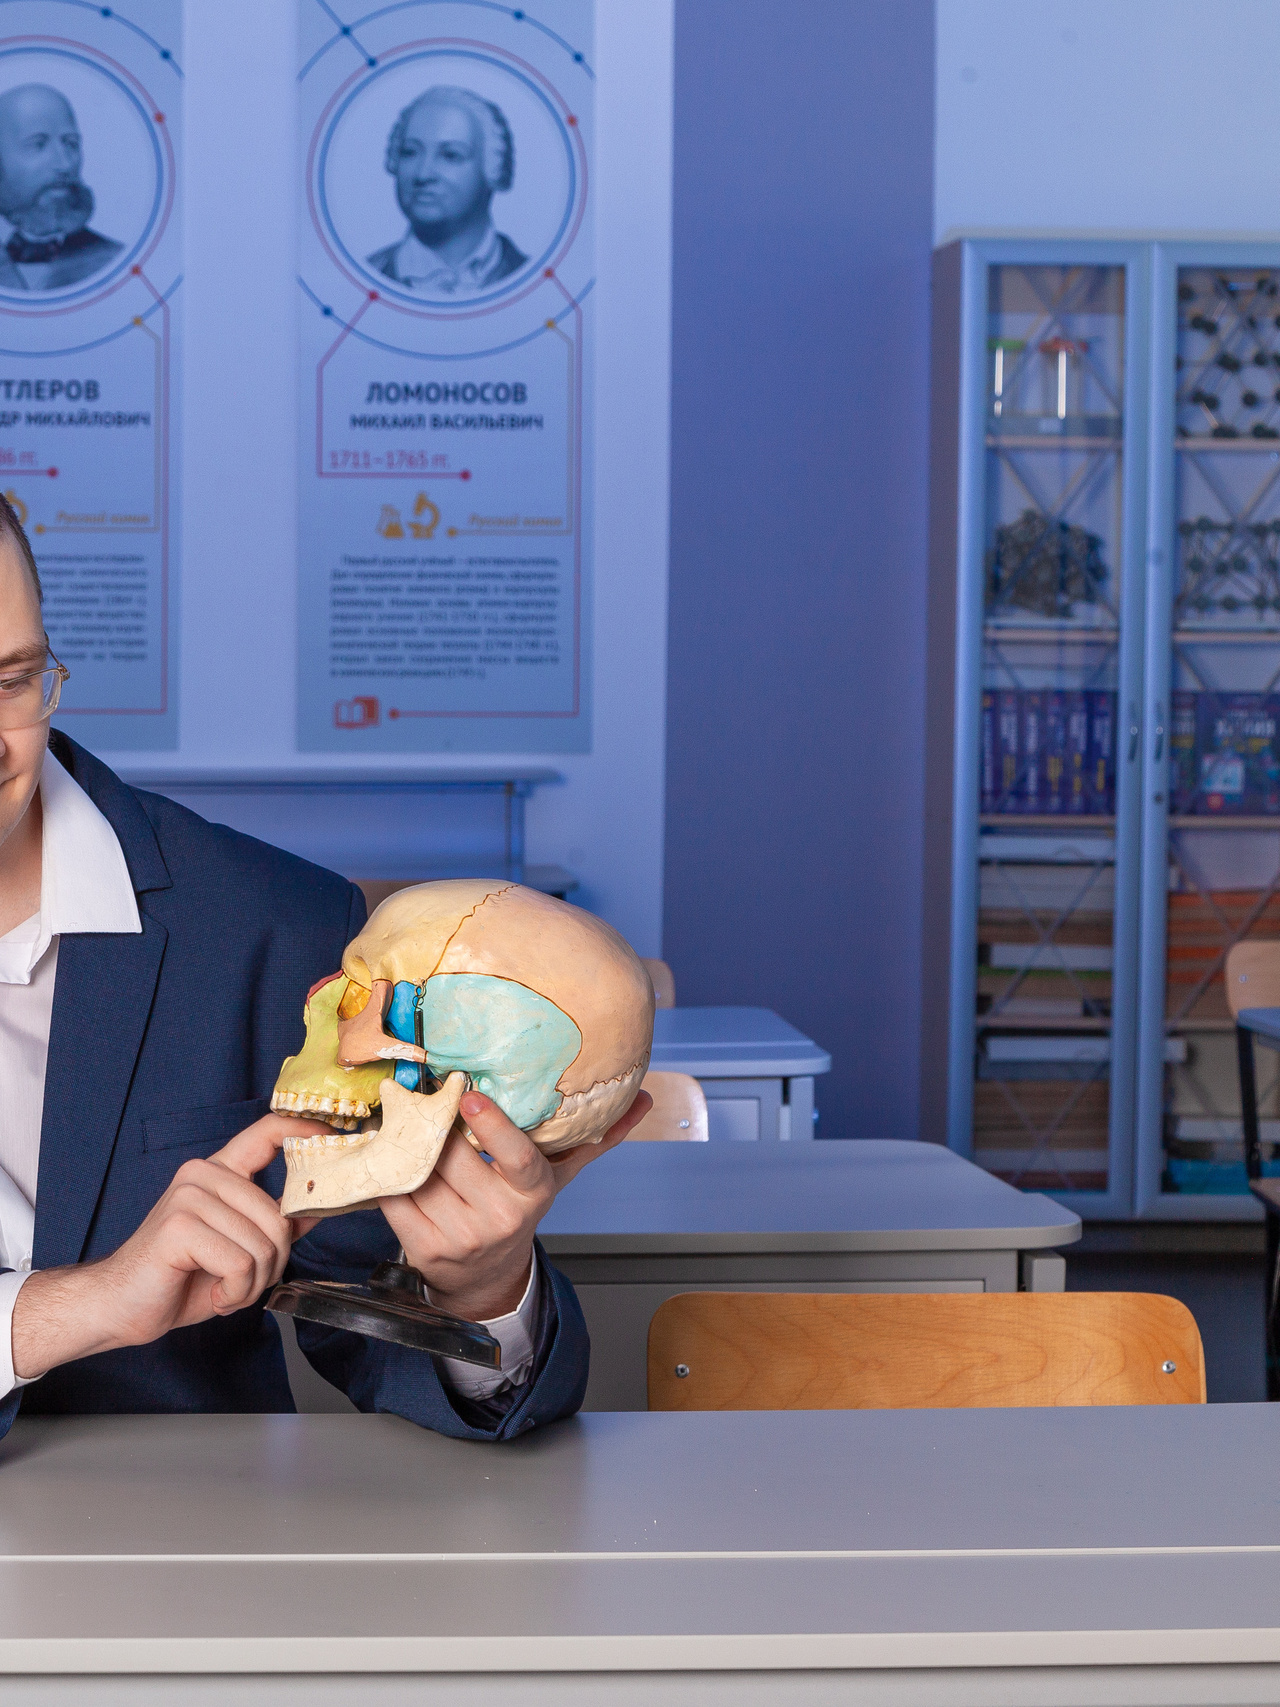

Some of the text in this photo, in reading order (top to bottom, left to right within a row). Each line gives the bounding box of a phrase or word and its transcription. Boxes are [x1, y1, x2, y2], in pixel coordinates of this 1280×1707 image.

[366, 381, 528, 405] ЛОМОНОСОВ
[25, 408, 151, 427] МИХАЙЛОВИЧ
[349, 414, 544, 430] МИХАИЛ ВАСИЛЬЕВИЧ
